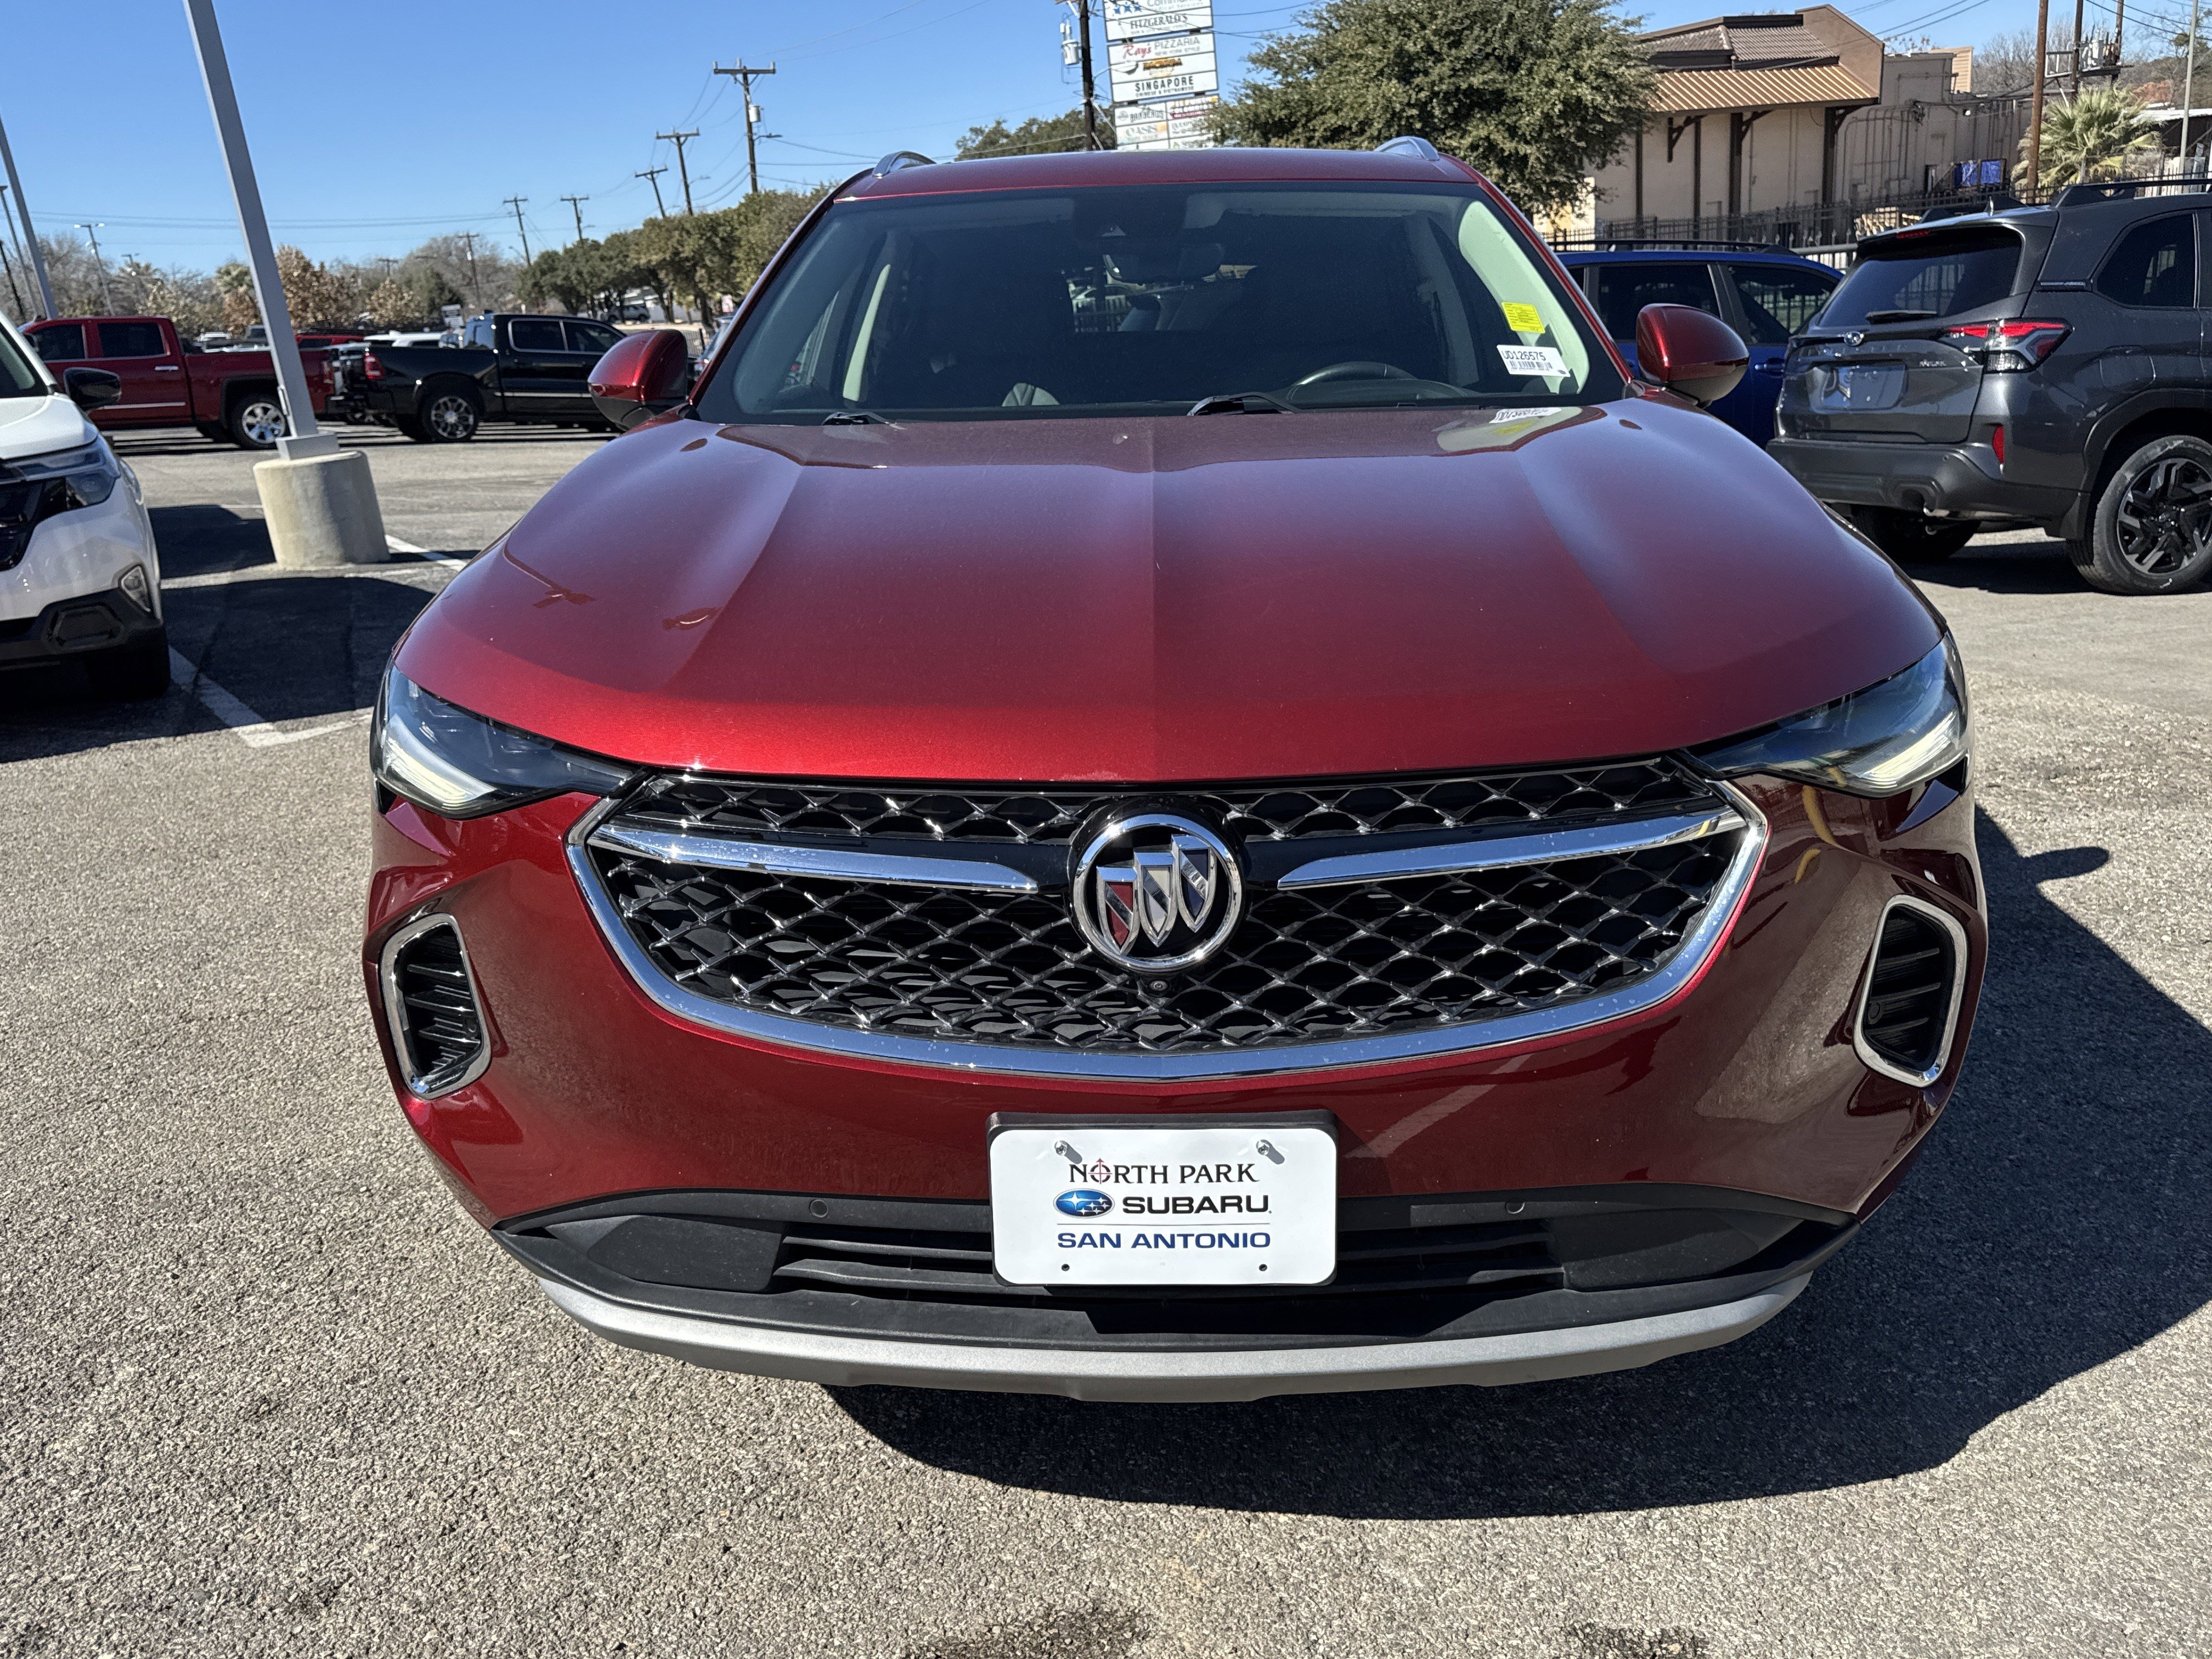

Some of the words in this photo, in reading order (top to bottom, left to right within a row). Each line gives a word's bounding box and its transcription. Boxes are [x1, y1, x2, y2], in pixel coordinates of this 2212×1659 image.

[1154, 37, 1200, 50] PIZZARIA
[1135, 76, 1194, 92] SINGAPORE
[1069, 1163, 1169, 1184] NORTH
[1180, 1163, 1260, 1183] PARK
[1122, 1195, 1269, 1214] SUBARU
[1058, 1233, 1122, 1248] SAN
[1131, 1232, 1271, 1249] ANTONIO
